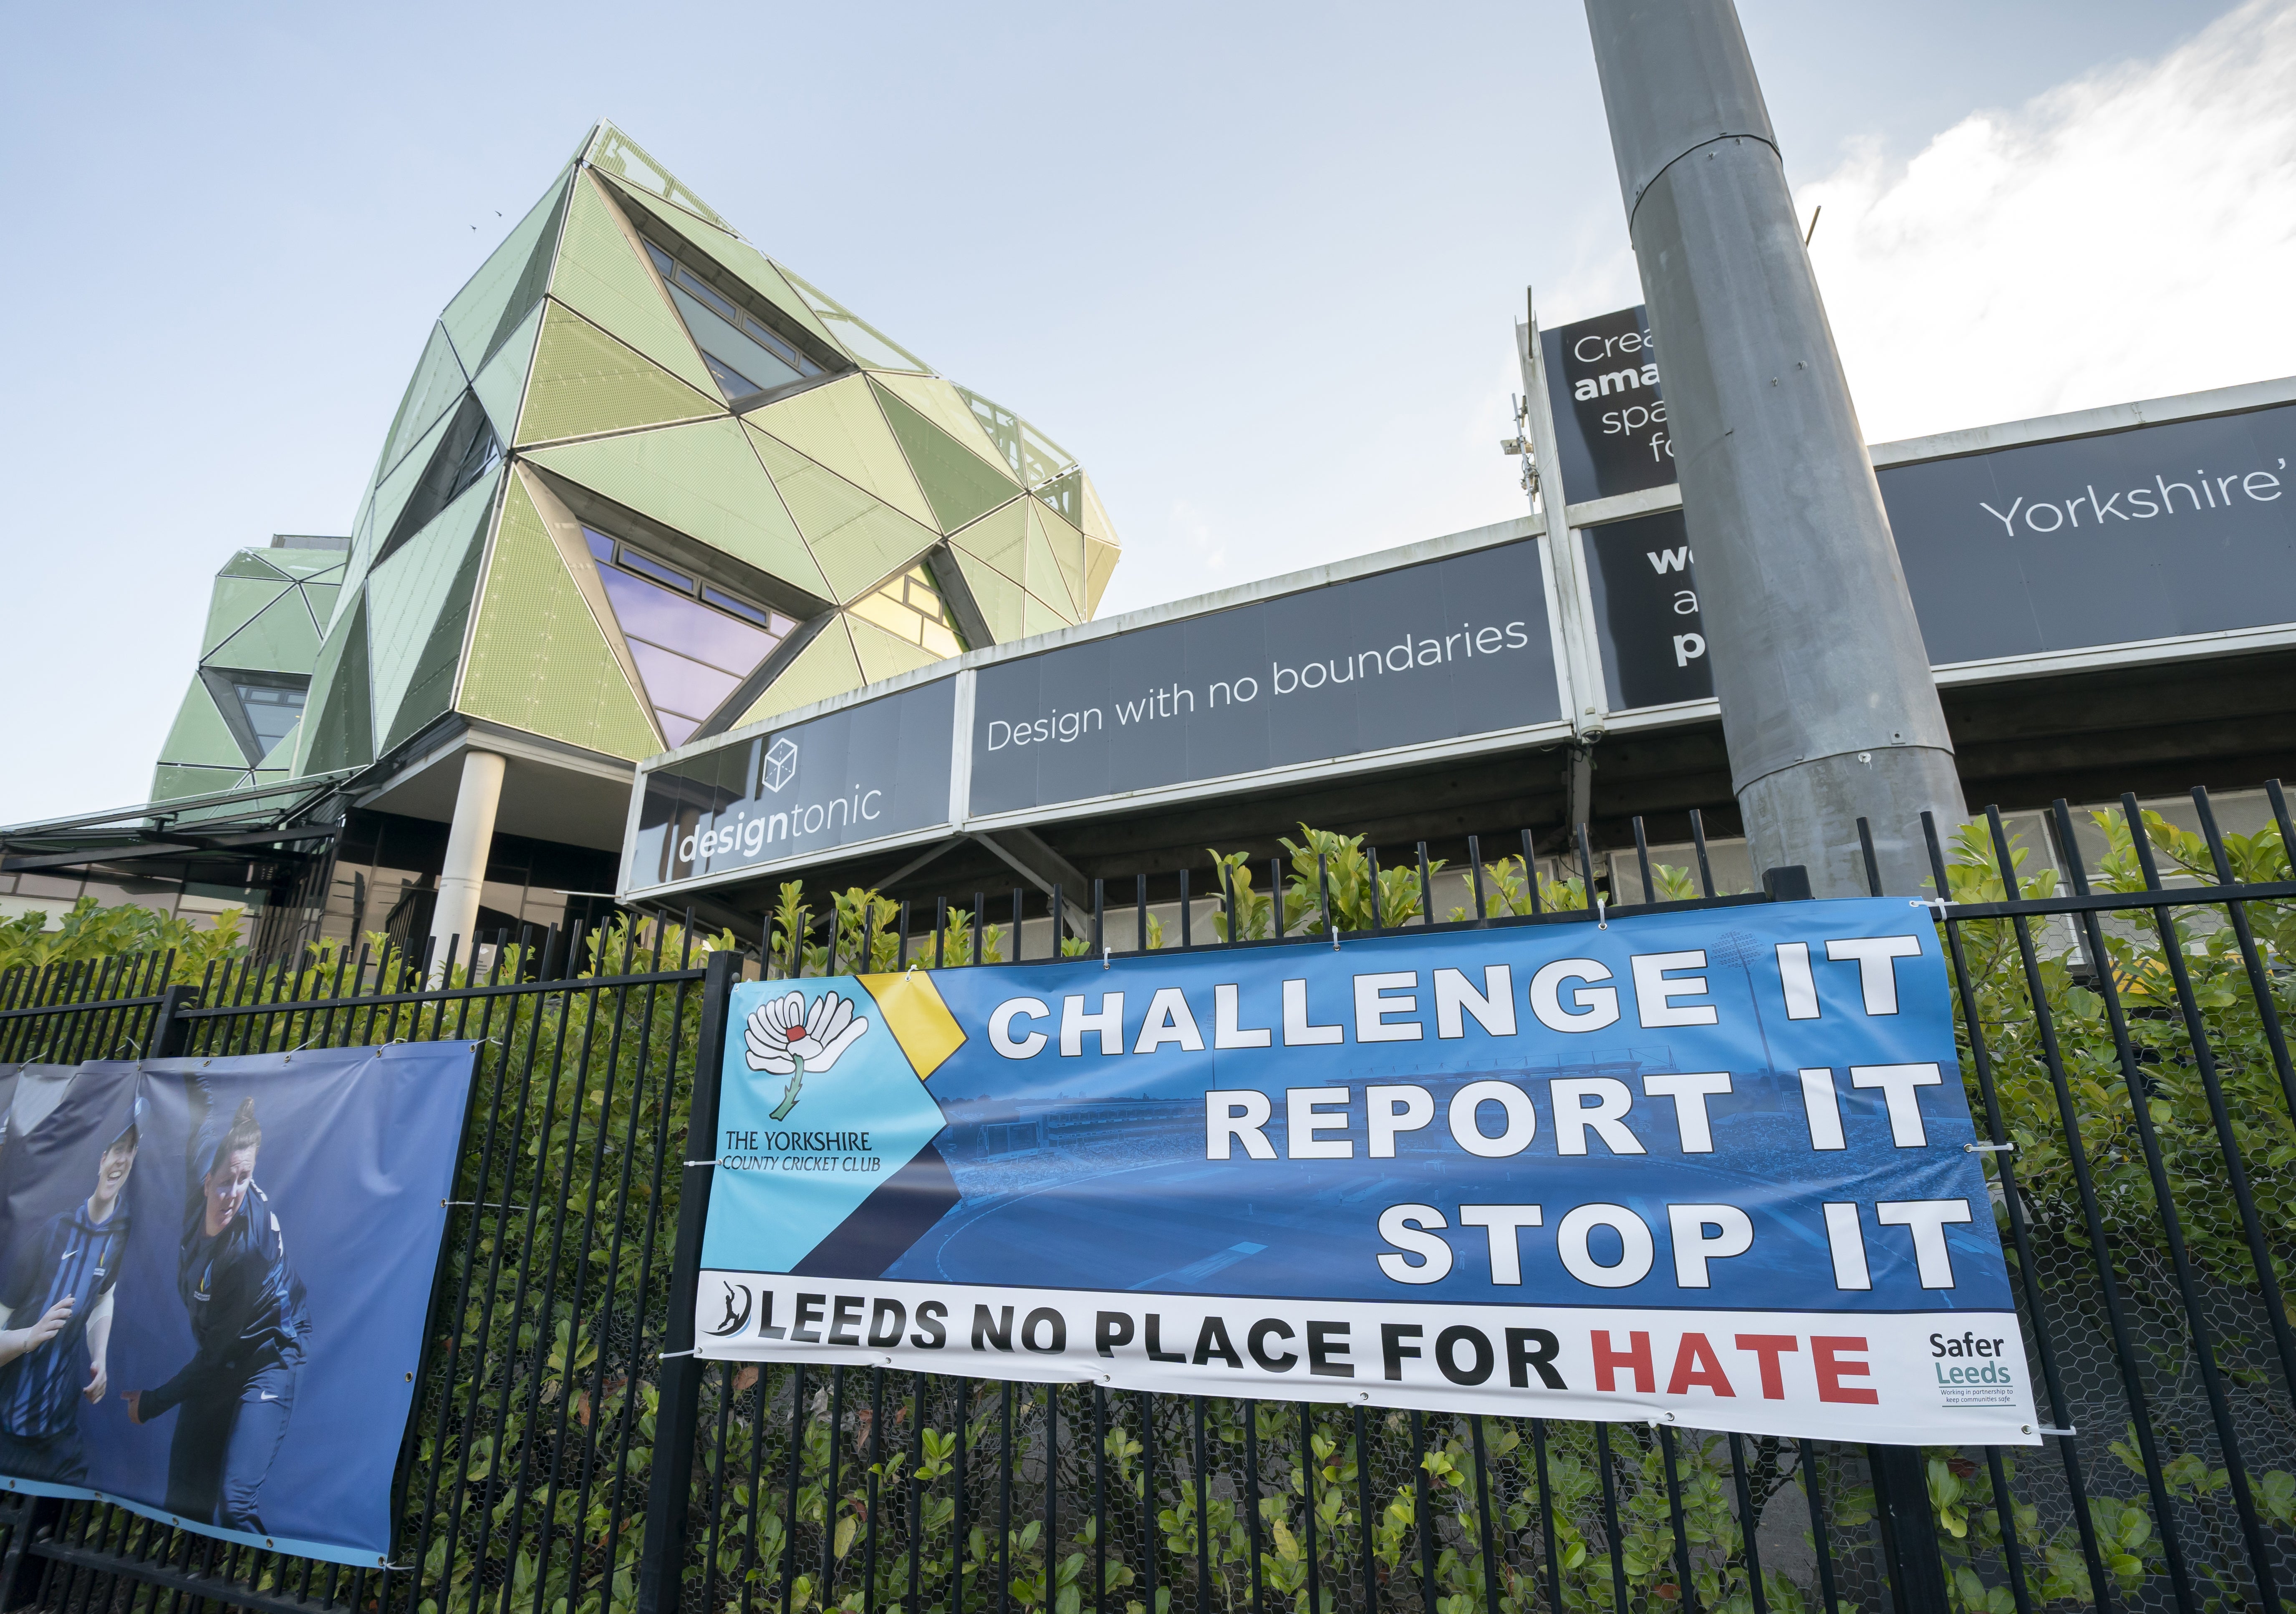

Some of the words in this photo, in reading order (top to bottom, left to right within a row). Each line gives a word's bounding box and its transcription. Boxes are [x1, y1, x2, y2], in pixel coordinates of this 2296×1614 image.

[1574, 363, 1660, 401] ama
[987, 708, 1103, 752] Design
[1115, 683, 1194, 725] with
[1209, 677, 1258, 708] no
[1273, 621, 1528, 695] boundaries
[679, 783, 882, 863] designtonic
[987, 950, 1718, 1060] CHALLENGE
[1775, 935, 1922, 1020] IT
[726, 1131, 758, 1150] THE
[764, 1131, 873, 1152] YORKSHIRE
[1205, 1072, 1733, 1160] REPORT
[1798, 1062, 1943, 1150] IT
[722, 1155, 780, 1170] COUNTY
[782, 1156, 839, 1171] CRICKET
[842, 1156, 881, 1172] CLUB
[1376, 1203, 1754, 1288] STOP
[1823, 1199, 1972, 1290] IT
[758, 1290, 949, 1350] LEEDS
[971, 1304, 1067, 1354] NO
[1095, 1310, 1355, 1378] PLACE
[1380, 1323, 1569, 1390] FOR
[1590, 1330, 1879, 1405] HATE
[1930, 1331, 2004, 1357] Safer
[1935, 1360, 2011, 1384] Leeds
